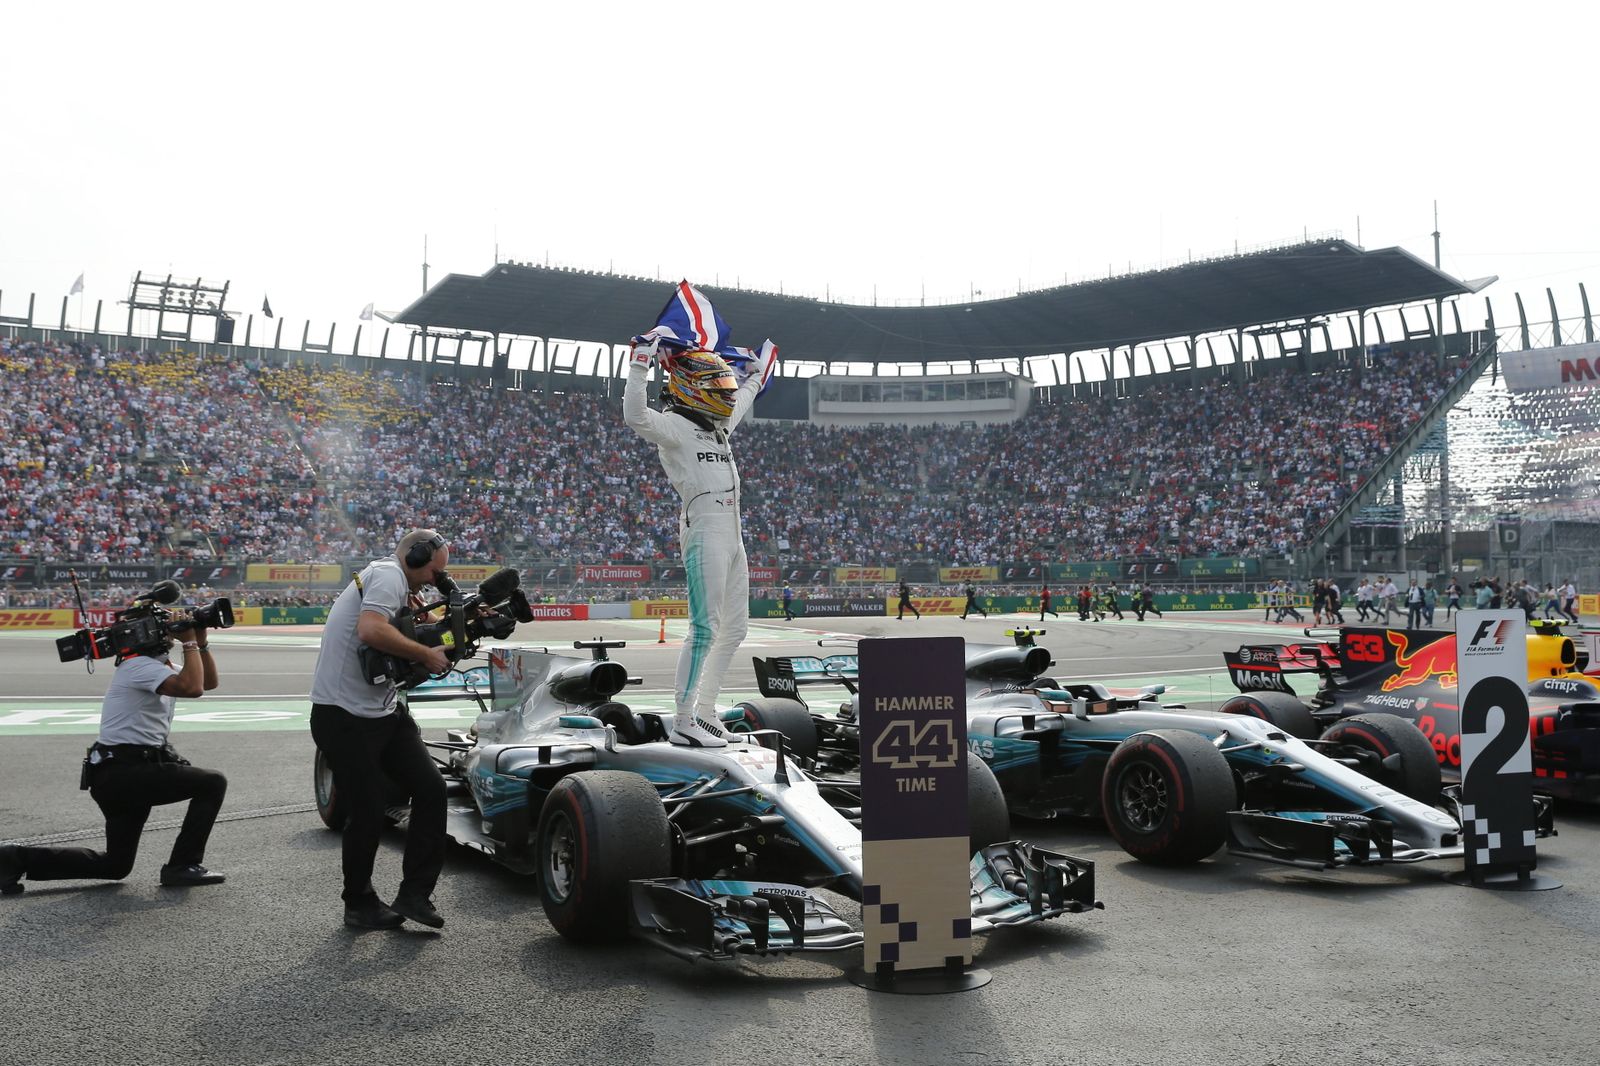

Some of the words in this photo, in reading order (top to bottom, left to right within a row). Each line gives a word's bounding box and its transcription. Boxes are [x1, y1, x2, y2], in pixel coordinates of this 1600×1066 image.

[1504, 529, 1517, 543] D
[108, 570, 148, 579] WALKER
[585, 568, 601, 581] Fly
[602, 568, 642, 579] Emirates
[846, 569, 883, 580] DHL
[949, 569, 984, 579] DHL
[805, 604, 841, 613] JOHNNIE
[850, 603, 884, 611] WALKER
[1346, 633, 1386, 662] 33
[767, 676, 795, 692] EPSON
[1237, 669, 1285, 690] Mobil
[875, 695, 955, 712] HAMMER
[872, 718, 959, 769] 44
[1461, 675, 1533, 799] 2
[896, 777, 936, 793] TIME
[757, 887, 808, 898] PETRONAS
